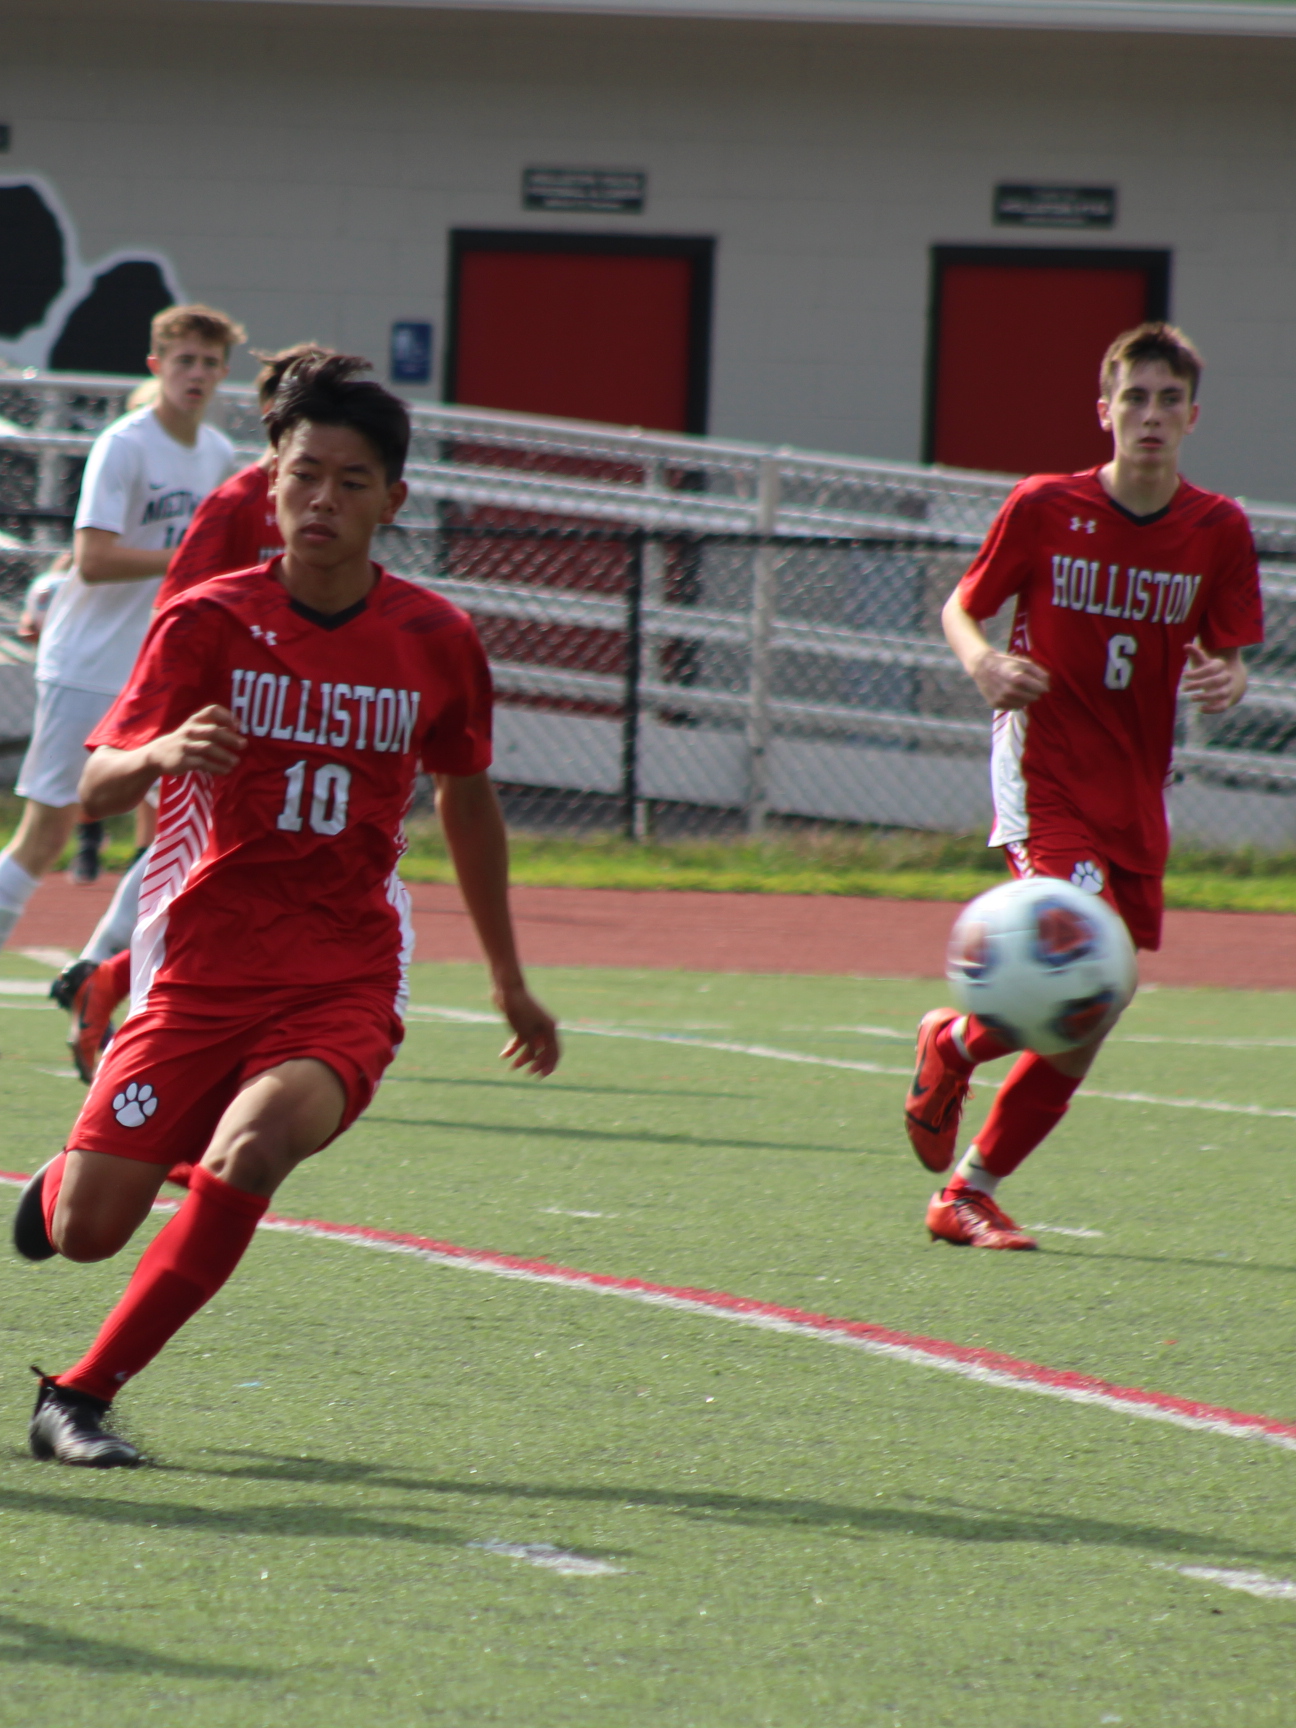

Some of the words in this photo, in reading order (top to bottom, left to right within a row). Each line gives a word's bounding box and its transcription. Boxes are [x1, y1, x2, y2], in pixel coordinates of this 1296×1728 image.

[1051, 554, 1202, 625] HOLLISTON
[1104, 633, 1138, 691] 6
[231, 668, 421, 755] HOLLISTON
[276, 759, 352, 836] 10
